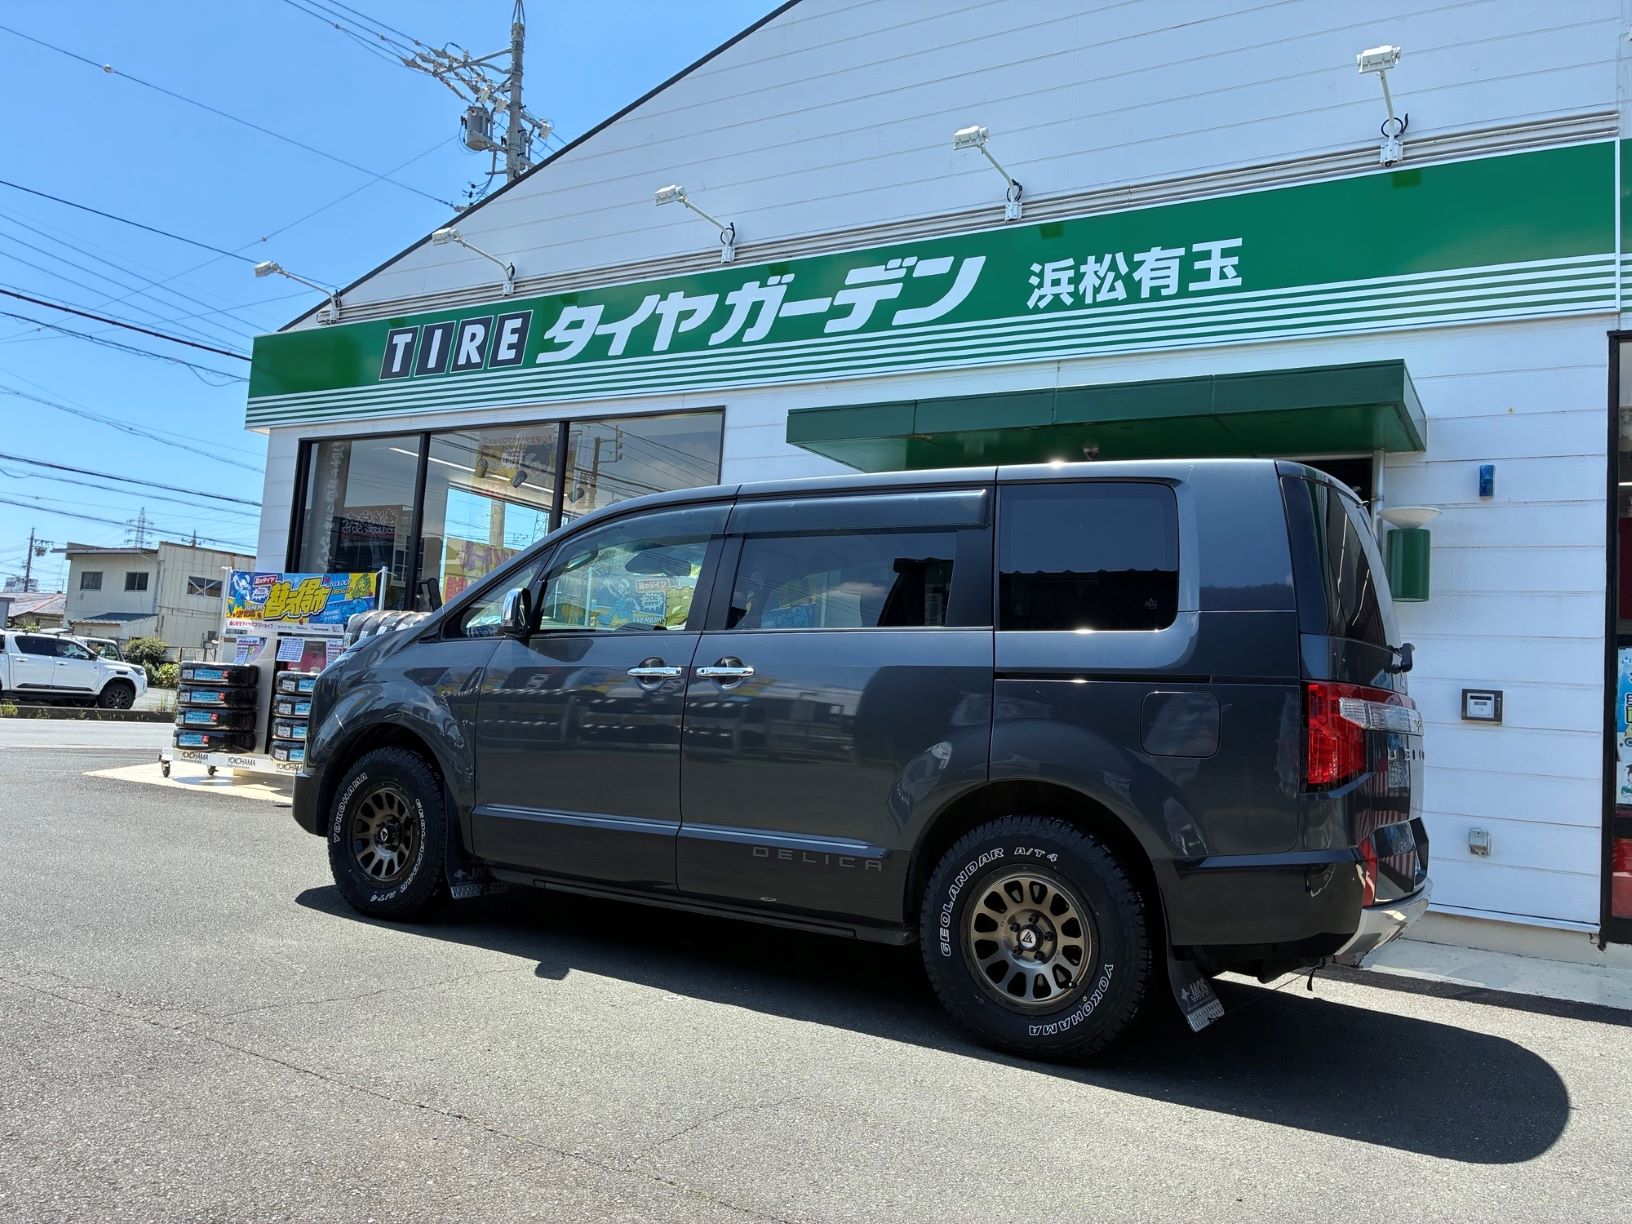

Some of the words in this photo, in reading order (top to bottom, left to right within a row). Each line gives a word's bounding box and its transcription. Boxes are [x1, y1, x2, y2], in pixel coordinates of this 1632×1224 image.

[536, 255, 987, 364] タイヤガーデン
[1026, 237, 1243, 310] 浜松有玉
[391, 317, 523, 373] TIRE
[228, 757, 256, 766] YOKOHAMA
[276, 763, 303, 772] YOKOHAM
[753, 846, 882, 871] DELICA
[939, 847, 1004, 957] GEOLANDAR
[1028, 963, 1114, 1036] YOKOHAMA
